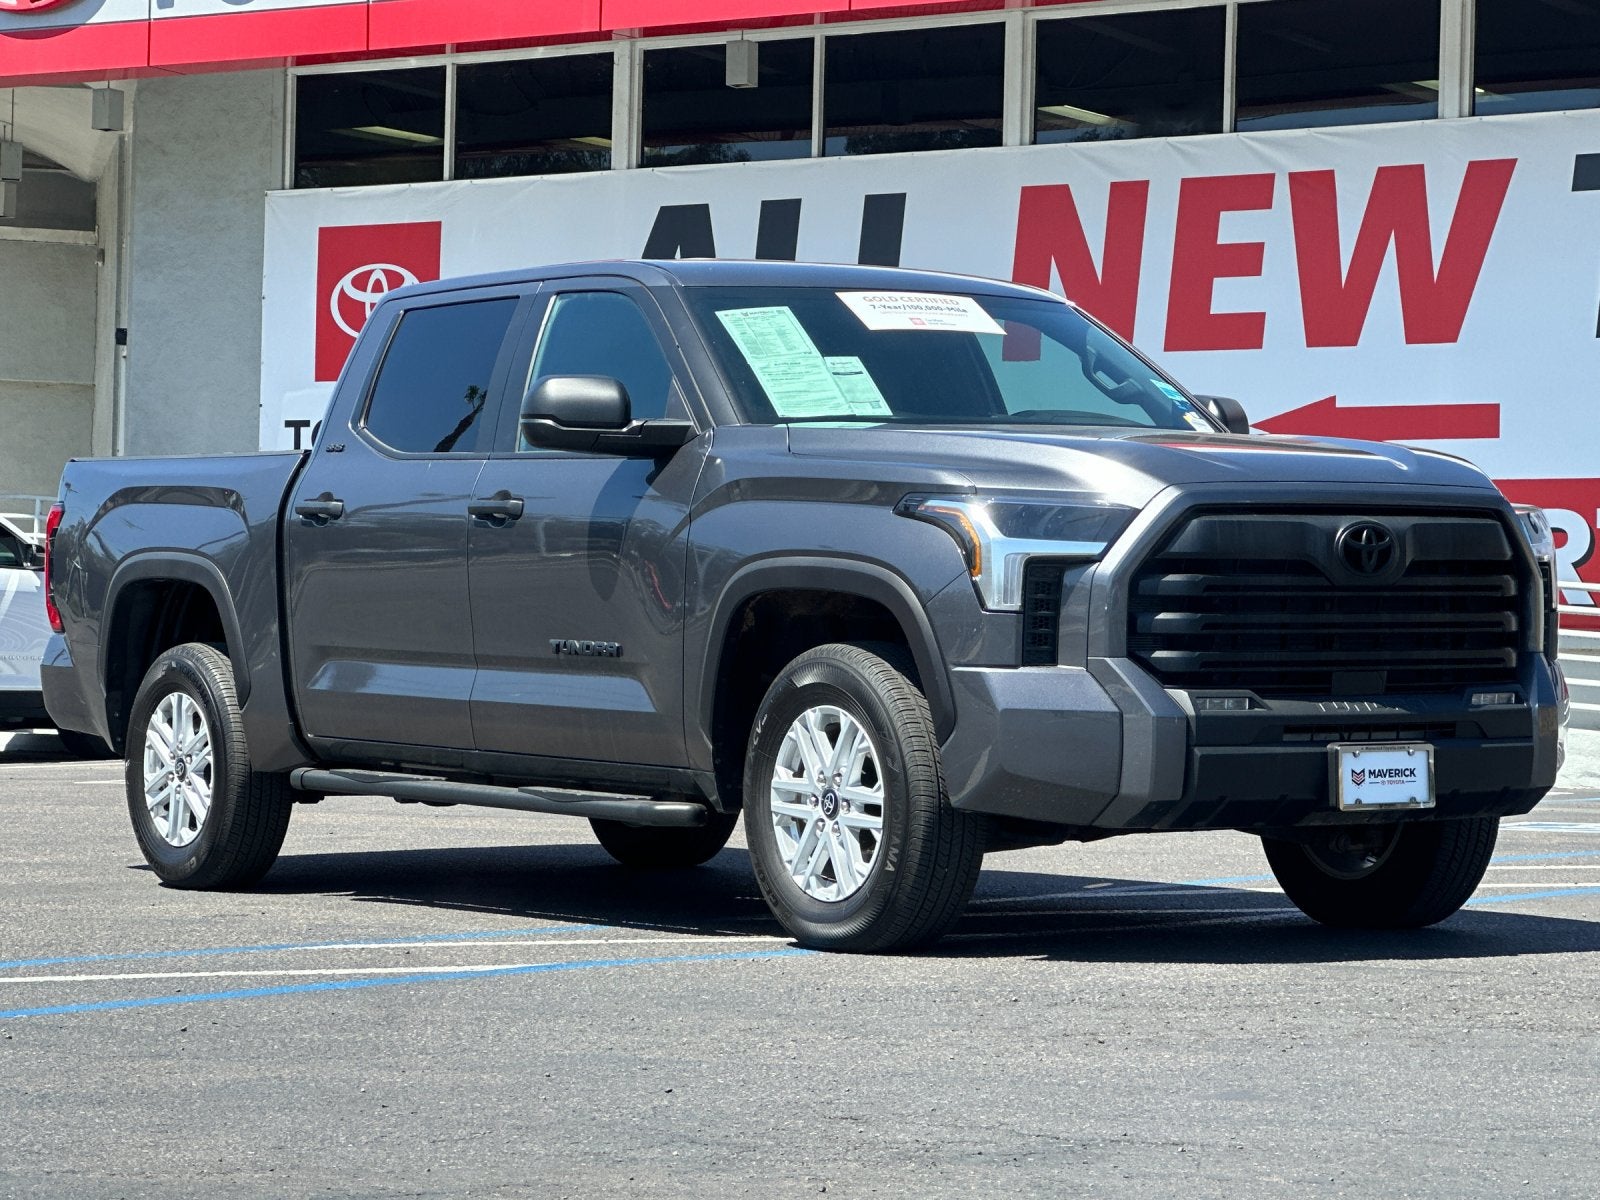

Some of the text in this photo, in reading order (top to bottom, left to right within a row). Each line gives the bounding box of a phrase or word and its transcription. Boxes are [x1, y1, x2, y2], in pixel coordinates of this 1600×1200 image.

[1004, 158, 1518, 353] NEW
[863, 295, 959, 306] GOLD CERTIFIED
[549, 638, 623, 657] TUNDRA
[1368, 767, 1417, 779] MAVERICK
